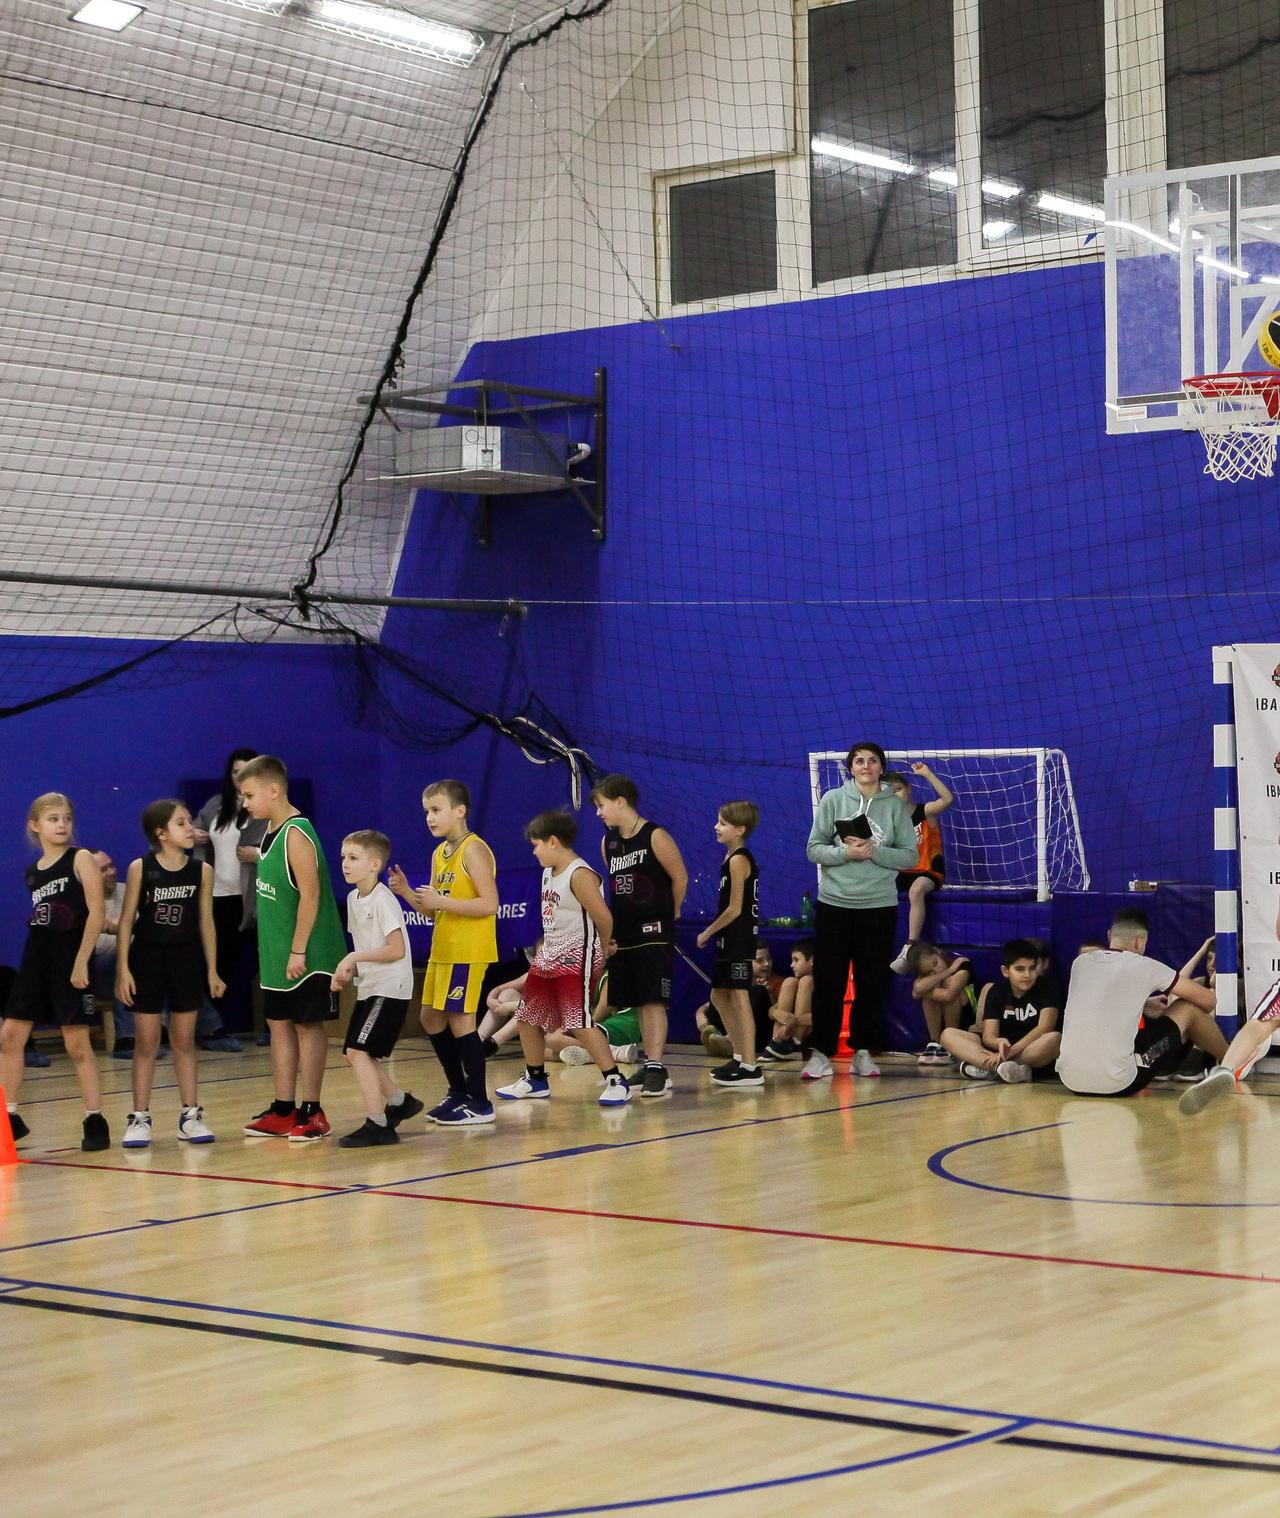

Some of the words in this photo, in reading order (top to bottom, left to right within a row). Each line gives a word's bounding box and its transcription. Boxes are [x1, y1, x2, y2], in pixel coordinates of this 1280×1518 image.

[610, 848, 647, 874] BASKET
[615, 874, 633, 894] 25
[153, 885, 197, 902] BASKET
[154, 903, 183, 926] 28
[402, 911, 435, 926] ORRE
[496, 902, 527, 919] RRES
[1003, 1003, 1038, 1021] FILA
